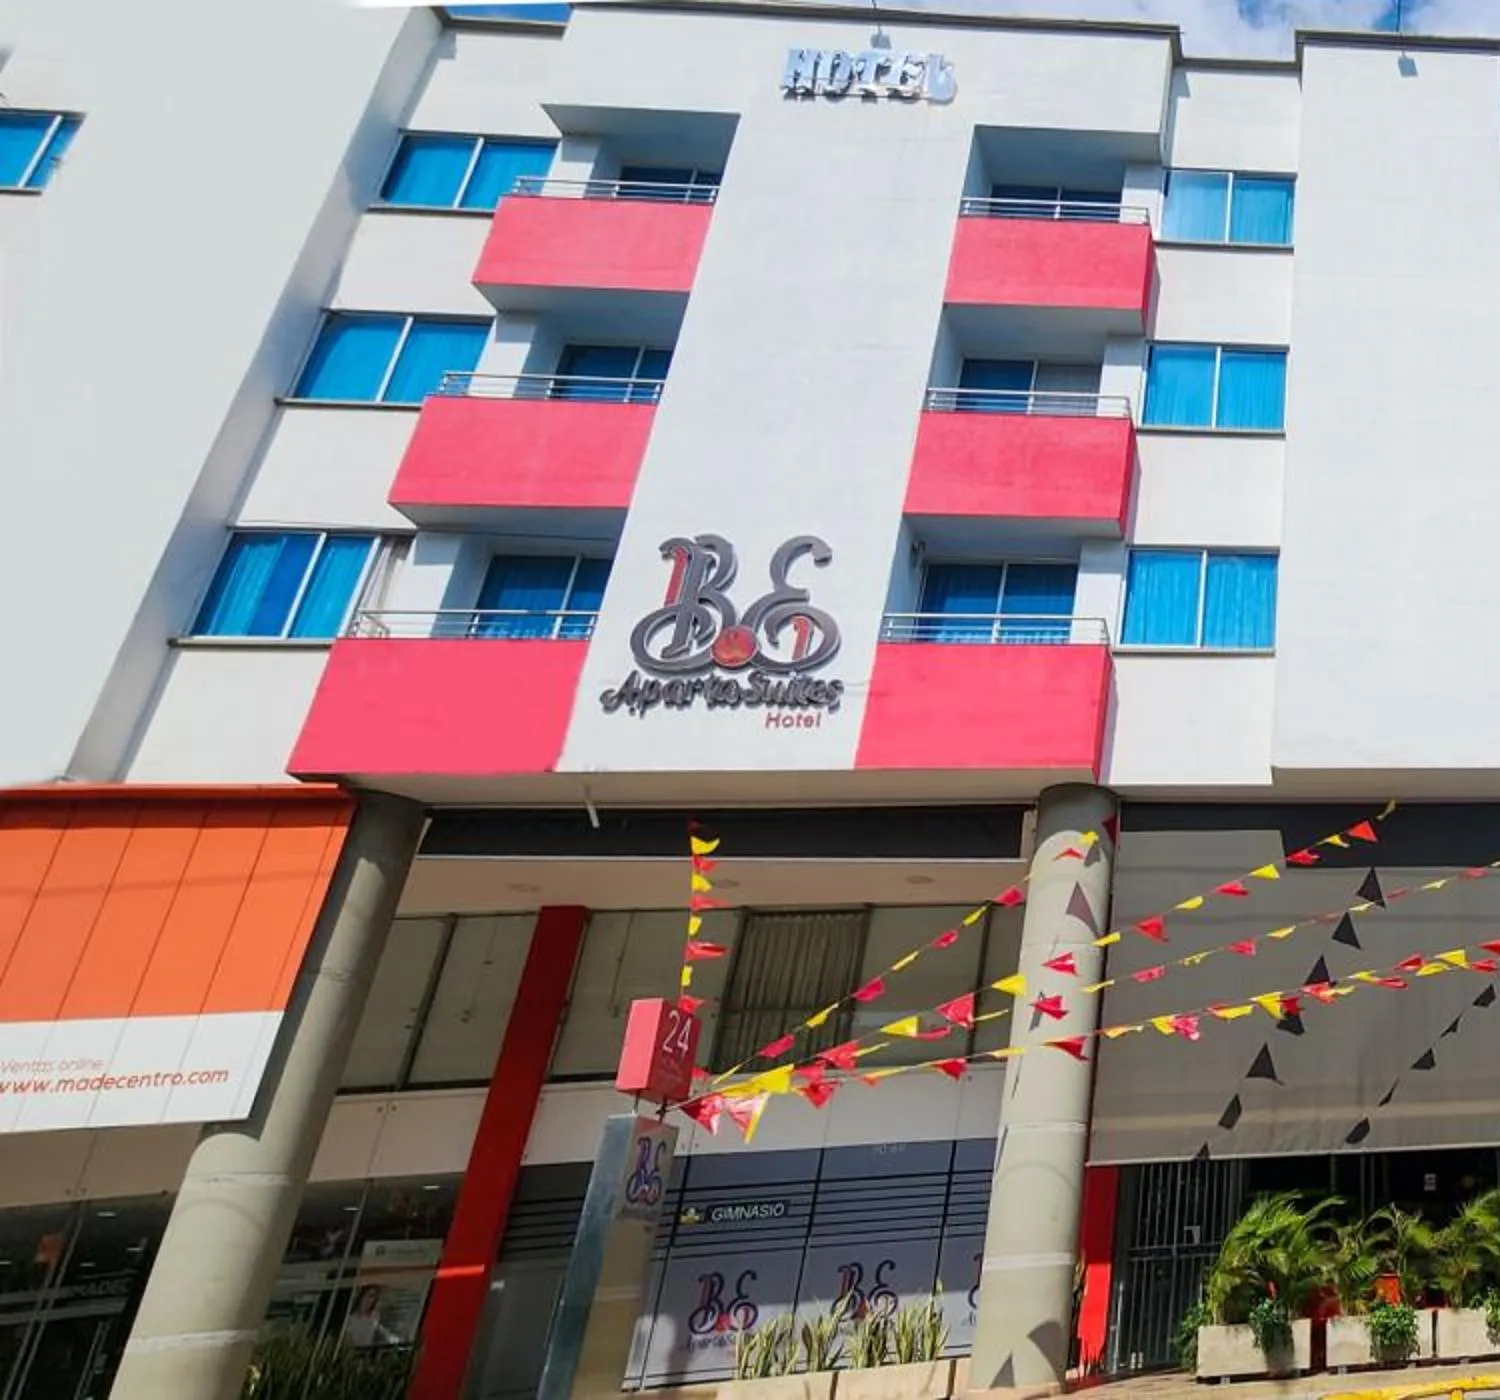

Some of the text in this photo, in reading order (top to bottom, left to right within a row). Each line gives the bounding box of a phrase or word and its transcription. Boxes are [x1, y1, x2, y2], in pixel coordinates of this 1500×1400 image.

[782, 49, 958, 105] HOTEL
[765, 711, 822, 729] Hotel
[663, 1009, 692, 1059] 24
[58, 1057, 104, 1072] online
[712, 1203, 785, 1221] GIMNASIO
